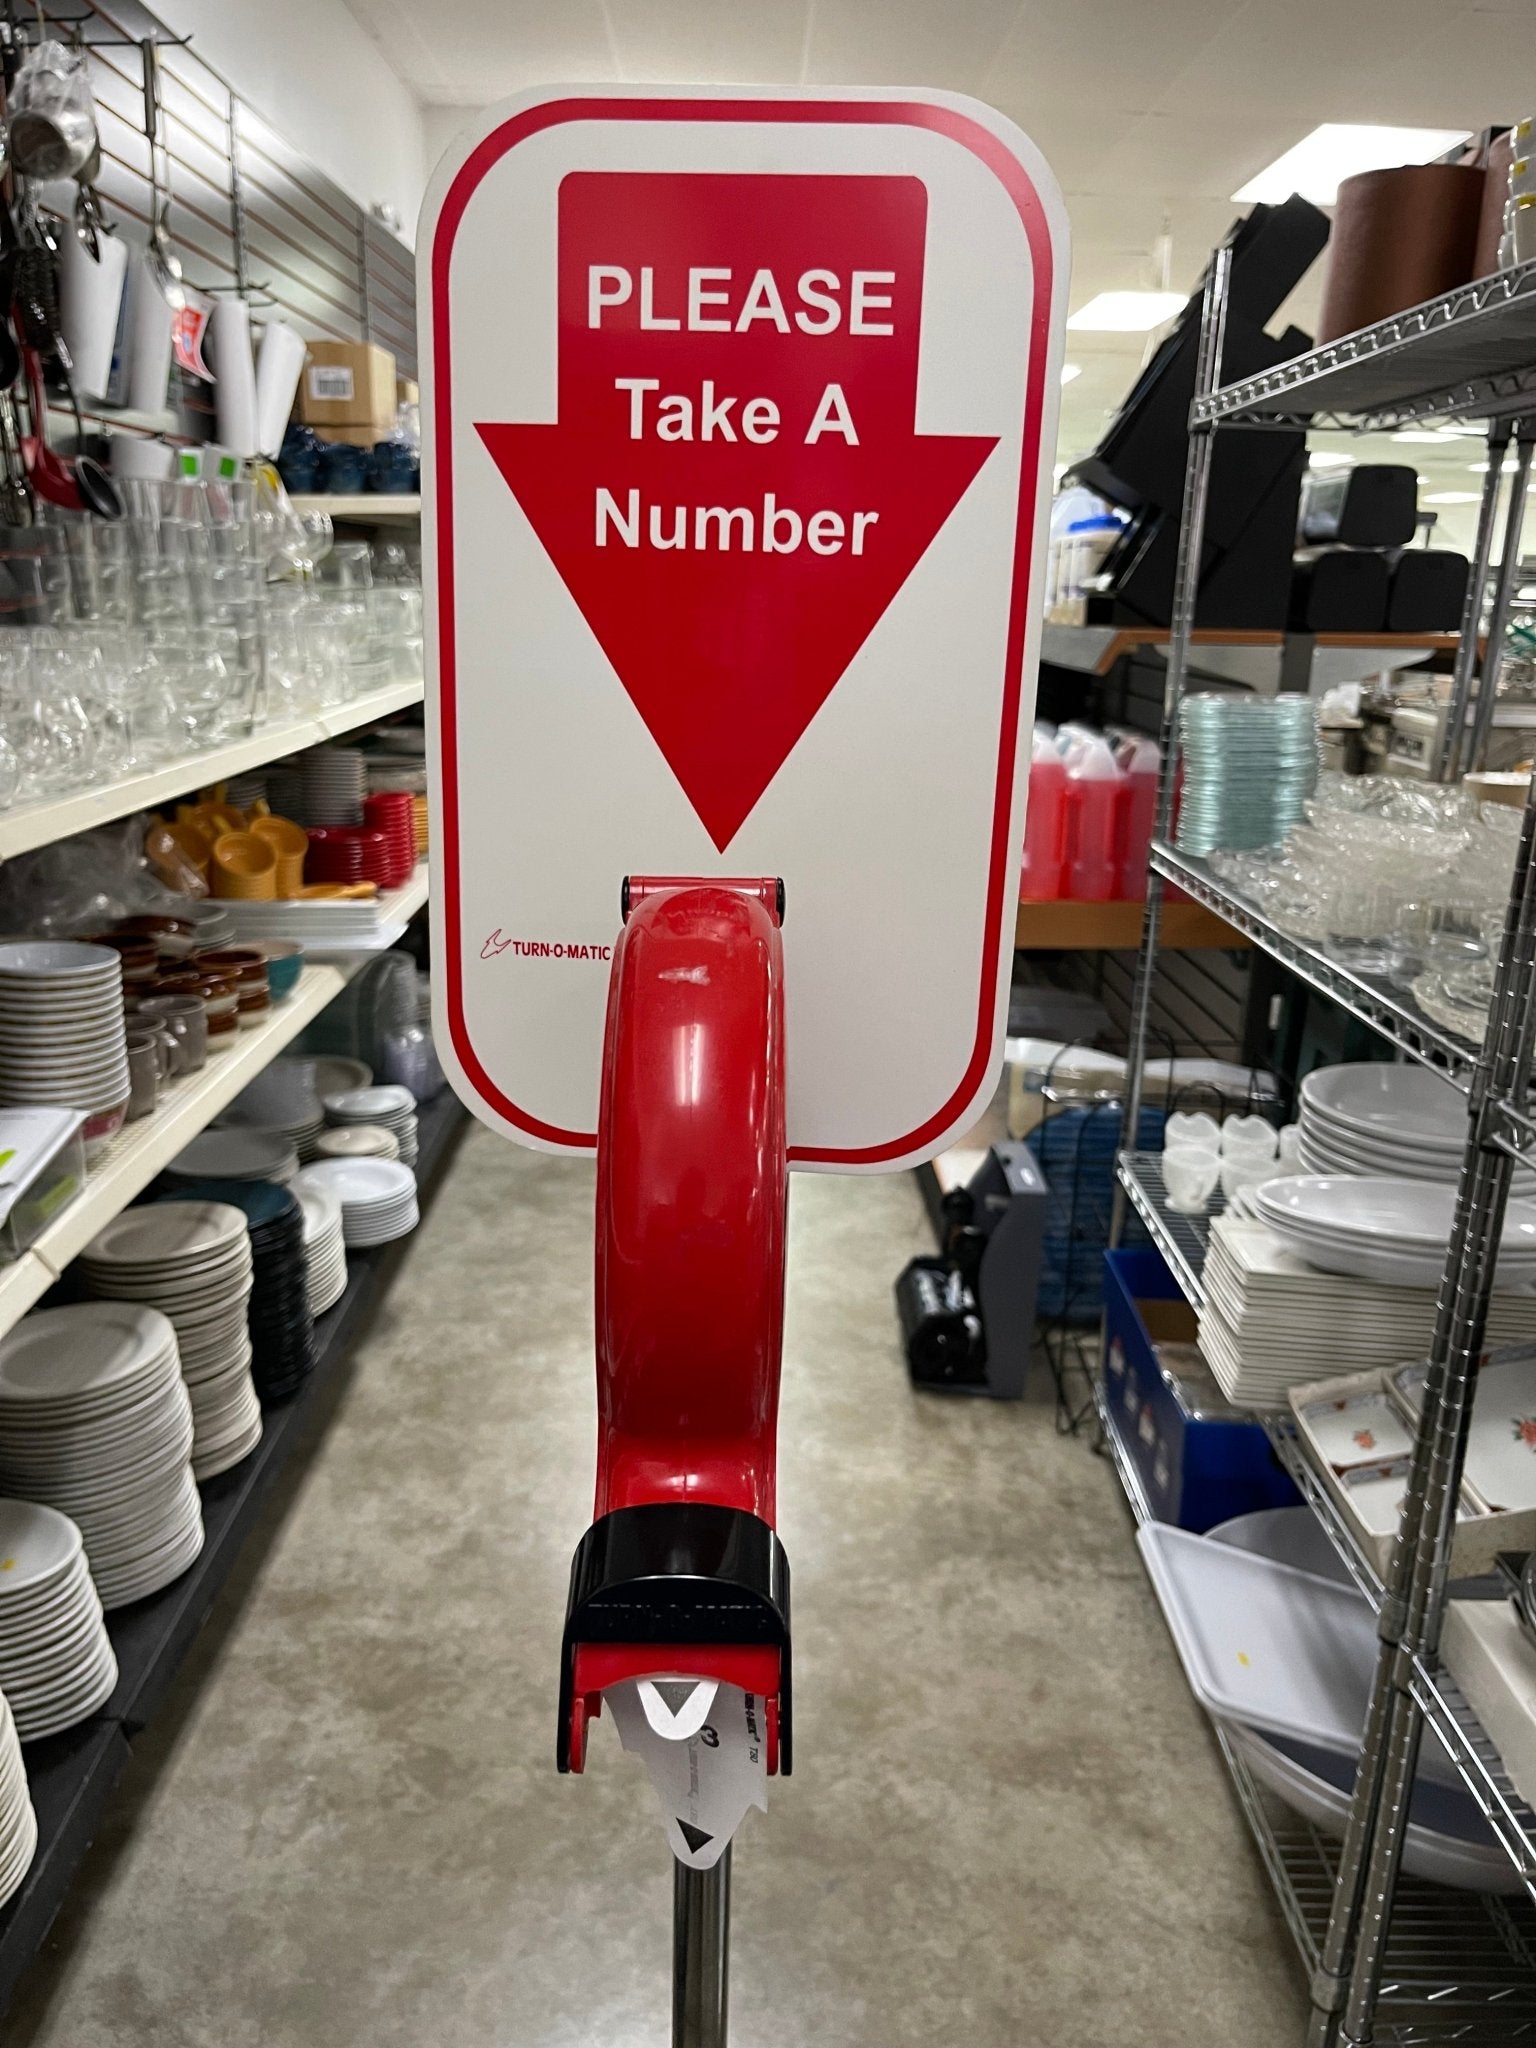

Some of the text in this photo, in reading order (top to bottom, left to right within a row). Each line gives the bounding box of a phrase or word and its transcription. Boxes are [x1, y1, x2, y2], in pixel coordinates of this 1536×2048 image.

[589, 266, 895, 335] PLEASE
[615, 379, 859, 445] Take A
[596, 488, 879, 555] Number
[513, 941, 610, 960] TURN-O-MATIC
